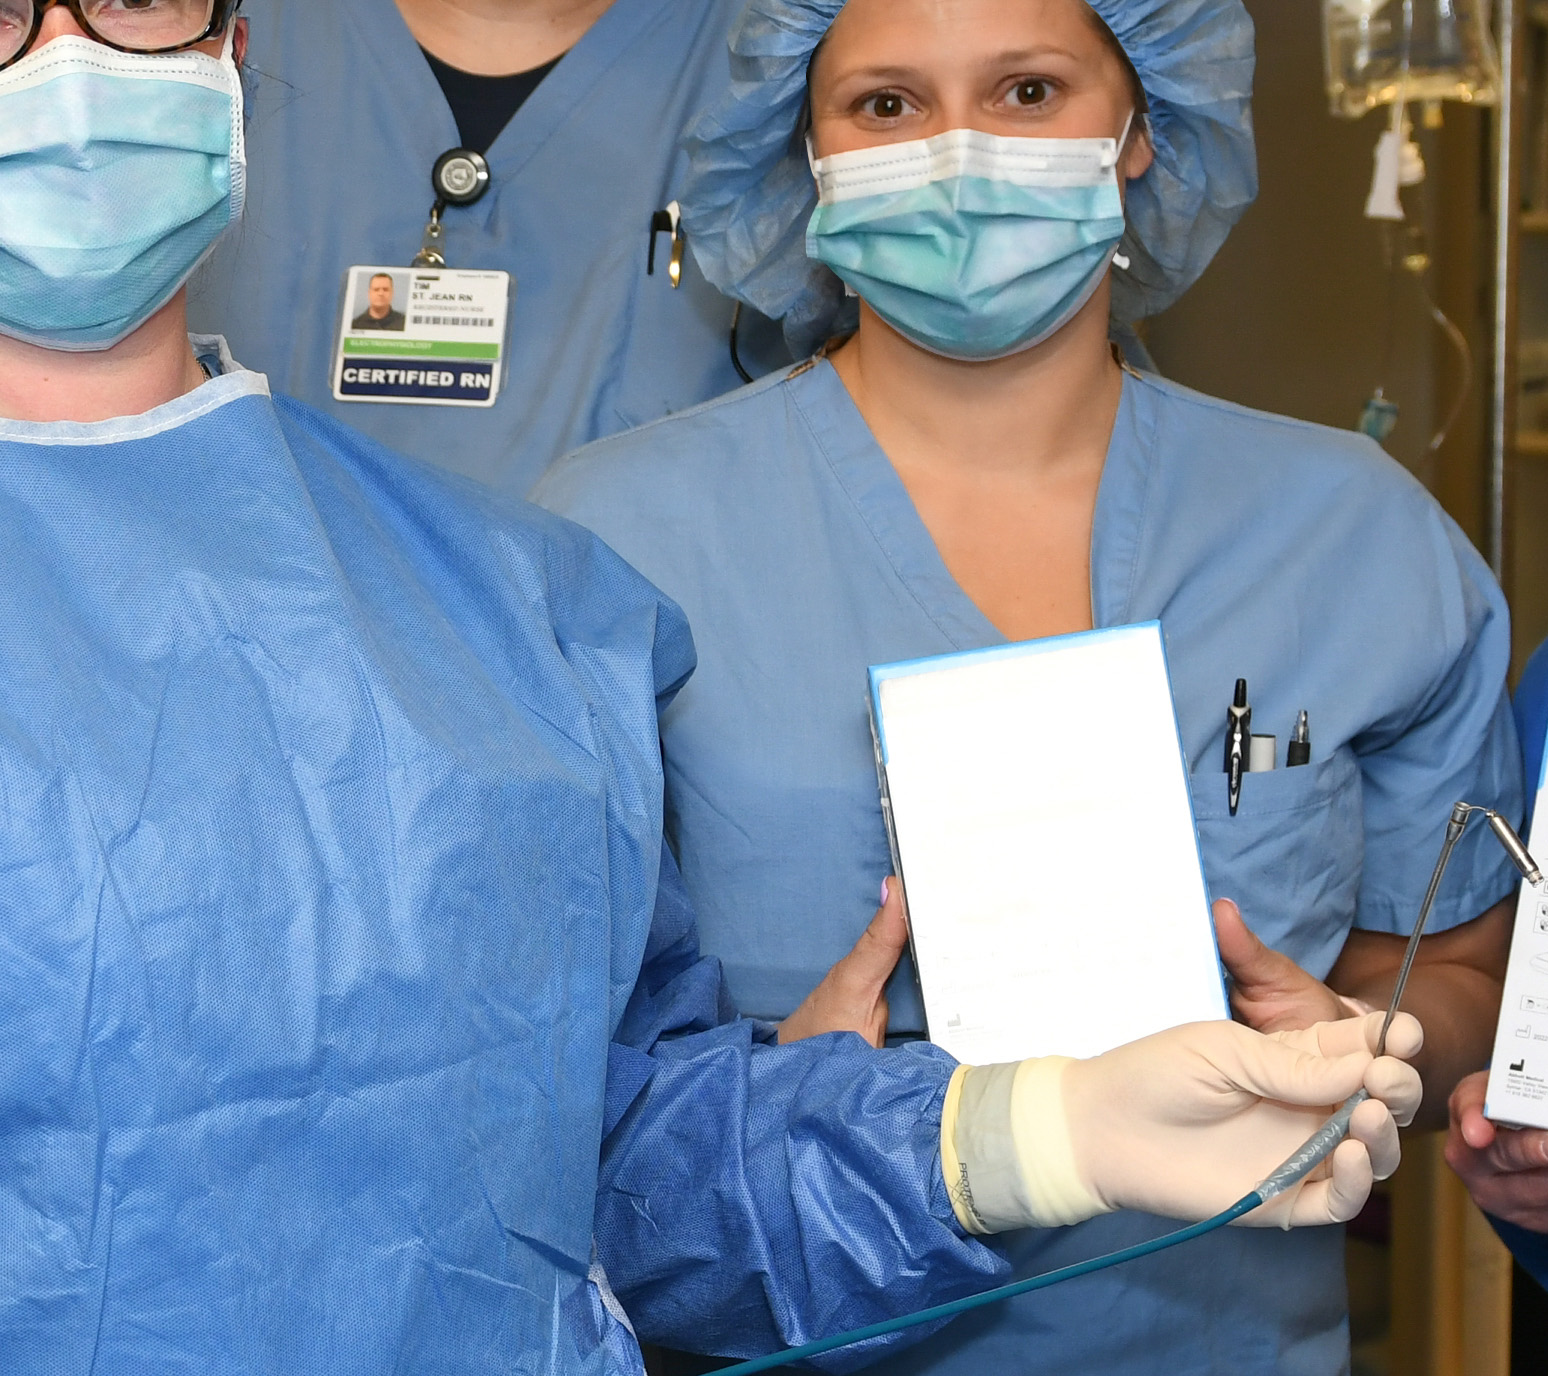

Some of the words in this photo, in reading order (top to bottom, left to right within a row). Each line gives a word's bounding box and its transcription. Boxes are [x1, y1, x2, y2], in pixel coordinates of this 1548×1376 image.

[413, 282, 431, 290] TIM
[429, 293, 456, 301] JEAN
[458, 294, 474, 302] RN
[343, 367, 455, 387] CERTIFIED
[459, 372, 491, 389] RN
